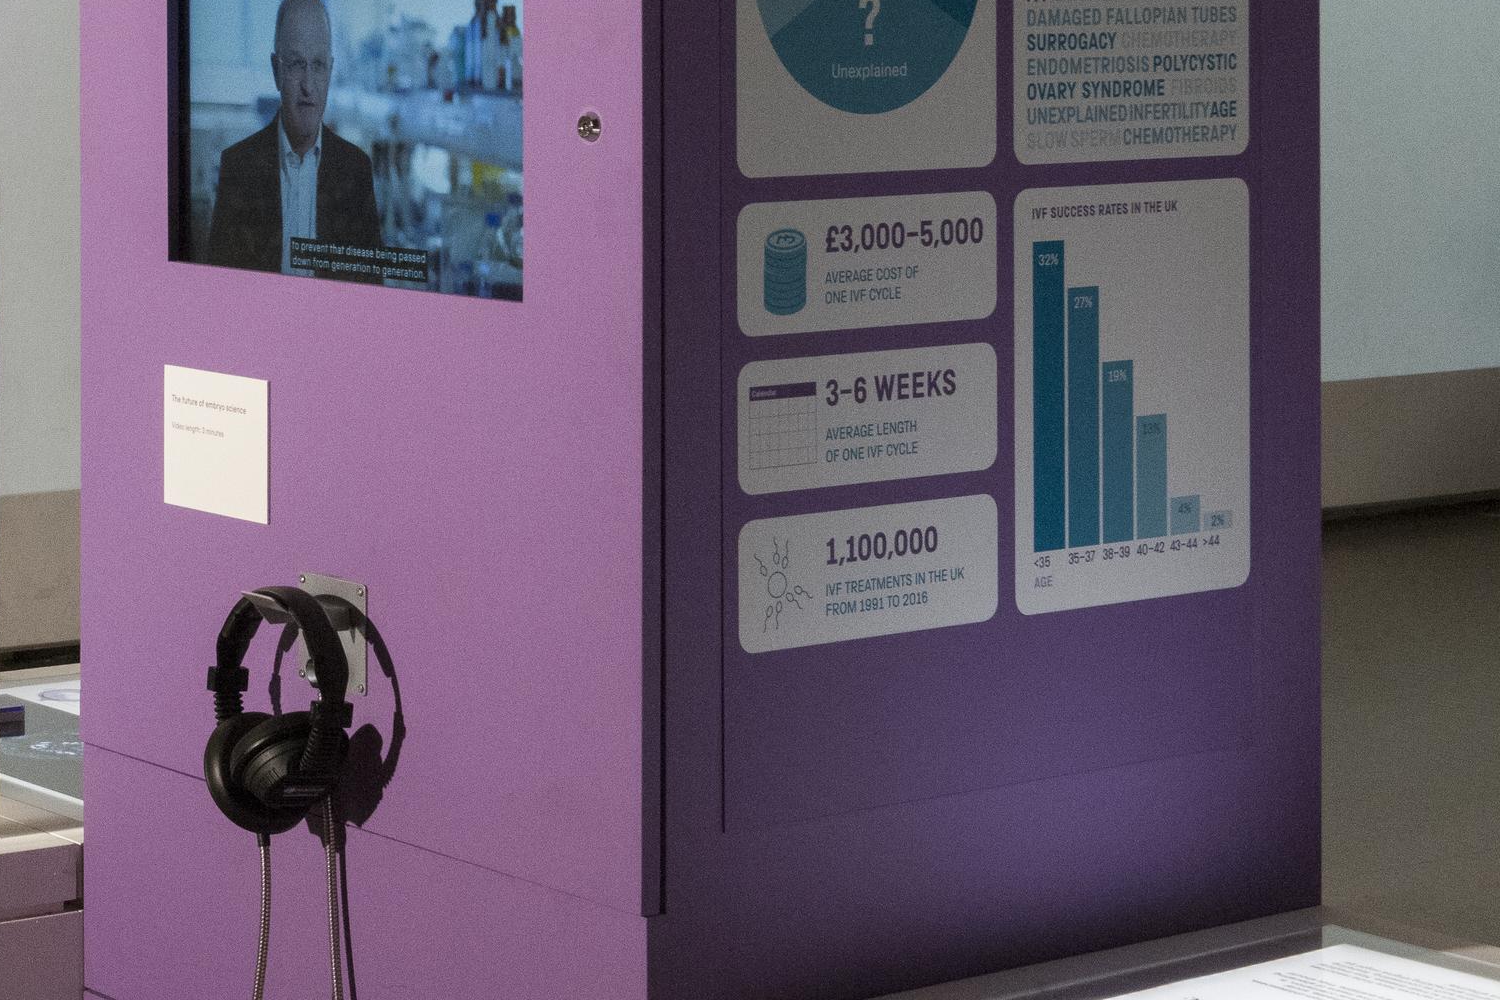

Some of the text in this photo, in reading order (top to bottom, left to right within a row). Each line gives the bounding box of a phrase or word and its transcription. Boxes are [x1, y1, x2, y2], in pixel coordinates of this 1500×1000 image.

[1027, 6, 1237, 27] DAMAGED FALLOPIAN TUBES
[1027, 32, 1116, 51] SURROGACY
[832, 62, 908, 80] Unexplained
[1027, 53, 1237, 75] ENDOMETRIOSIS POLYCYSTIC
[1027, 82, 1075, 100] OVARY
[1082, 79, 1165, 98] SYNDROME
[1027, 100, 1237, 125] UNEXPLAINED INFERTILITY AGE
[1123, 124, 1237, 145] CHEMOTHERAPY
[1032, 200, 1178, 220] IVF SUCCESS RATES IN THE UK
[291, 240, 426, 264] to prevent that disease being passed
[1038, 253, 1059, 266] 32%
[292, 256, 426, 280] down from generation to generation.
[825, 265, 919, 284] AVERAGE COST OF
[825, 286, 902, 305] ONE IVF CYCLE
[1074, 296, 1093, 309] 27%
[874, 369, 956, 401] WEEKS
[1108, 369, 1127, 383] 19%
[825, 420, 917, 441] AVERAGE LENGTH
[826, 441, 918, 463] OF ONE IVF CYCLE
[826, 526, 938, 566] 1,100,000
[826, 567, 965, 596] IVF TREATMENTS IN THE UK
[1034, 575, 1053, 589] AGE
[826, 592, 928, 616] FROM 1991 TO 2016
